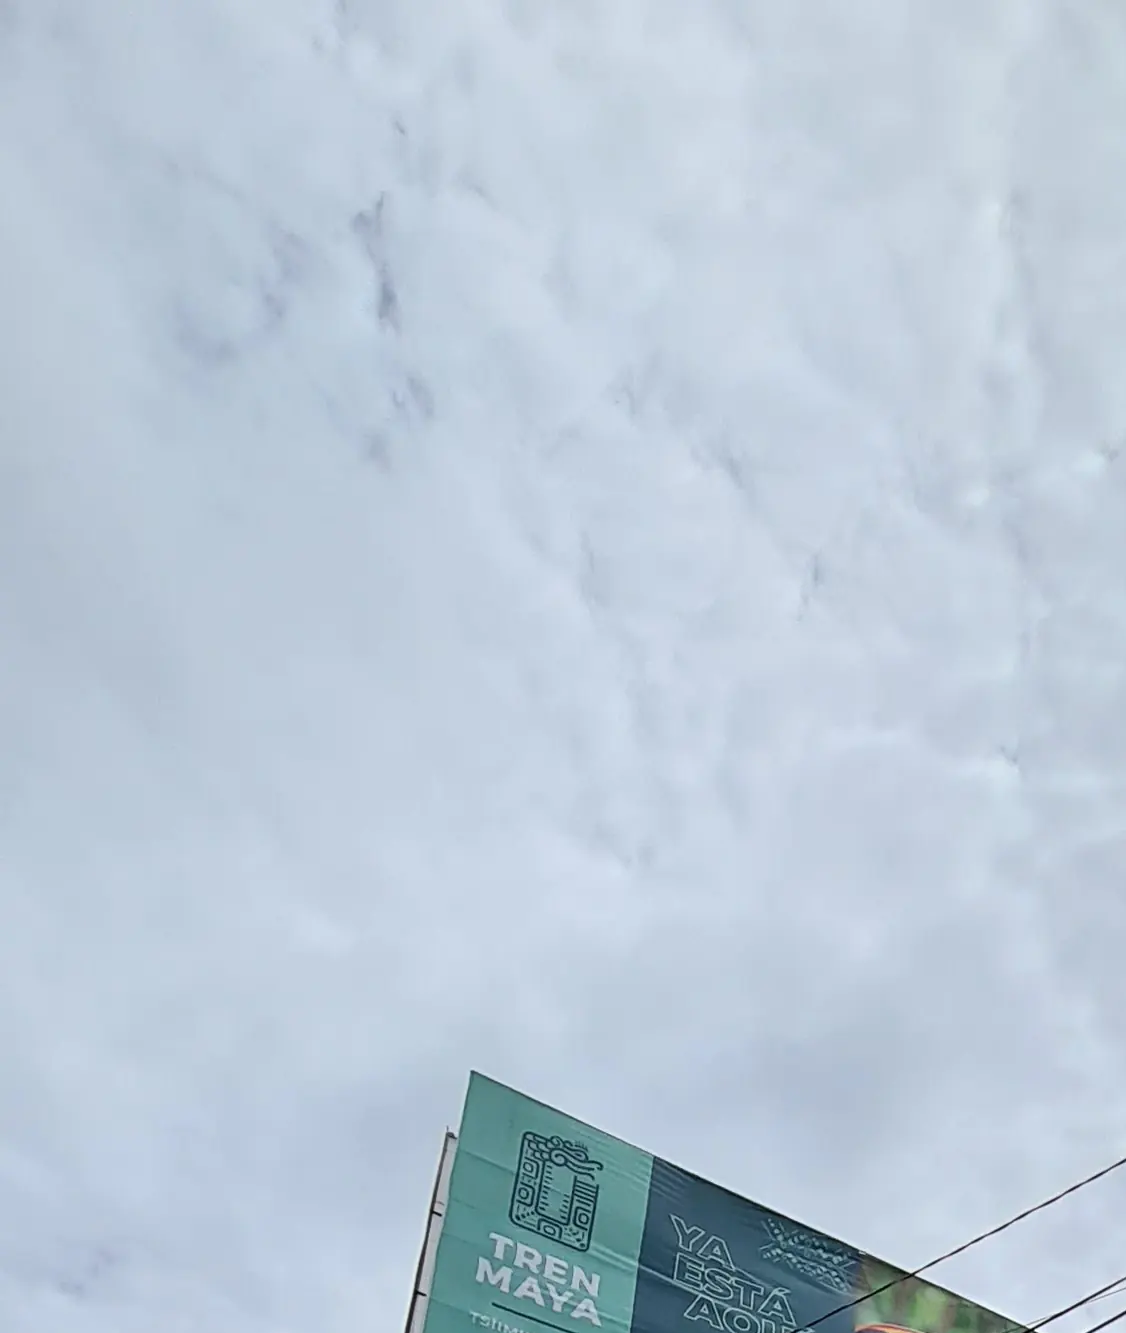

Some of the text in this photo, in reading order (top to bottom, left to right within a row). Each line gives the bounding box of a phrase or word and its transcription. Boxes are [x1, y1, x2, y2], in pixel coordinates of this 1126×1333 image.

[489, 1232, 600, 1298] TREN
[669, 1213, 735, 1272] YA
[475, 1256, 602, 1327] MAYA
[673, 1251, 797, 1326] ESTÁ
